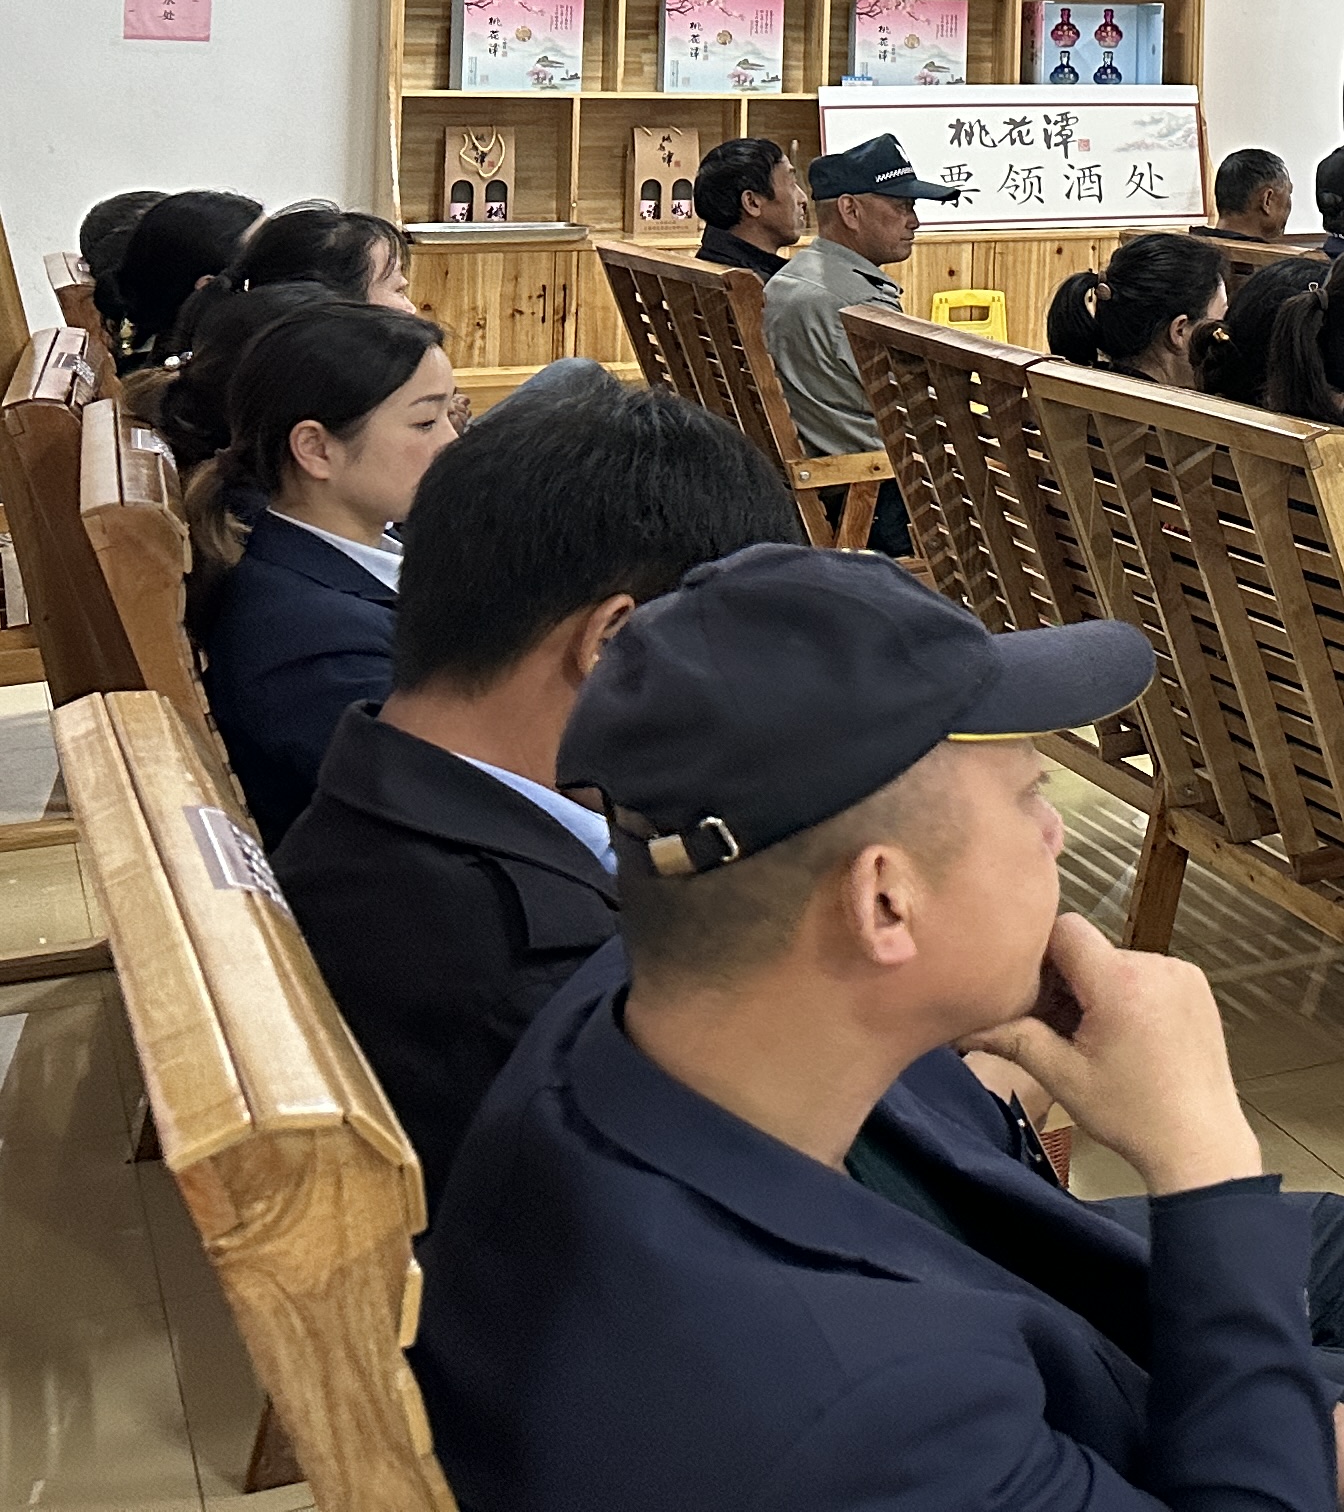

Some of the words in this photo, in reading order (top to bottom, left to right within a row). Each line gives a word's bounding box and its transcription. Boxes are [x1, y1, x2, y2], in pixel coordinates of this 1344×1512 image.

[947, 110, 1080, 159] 桃花潭
[938, 161, 1171, 207] 票领酒处
